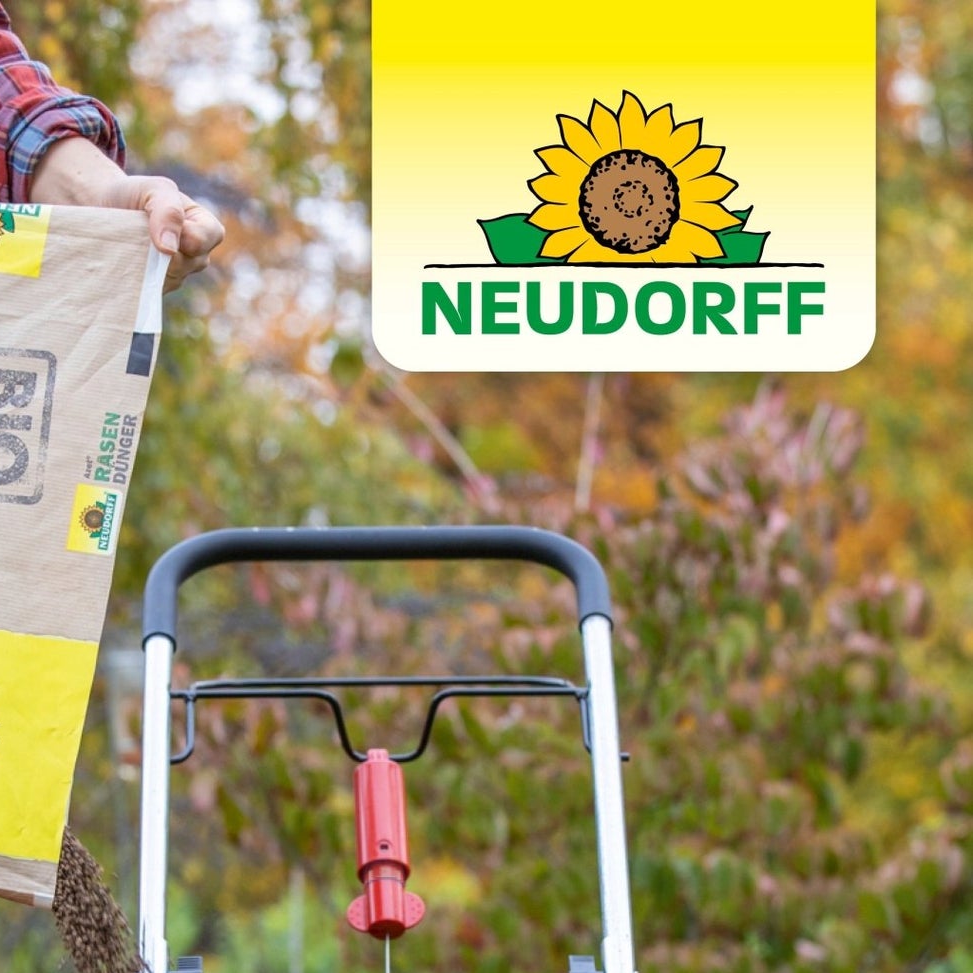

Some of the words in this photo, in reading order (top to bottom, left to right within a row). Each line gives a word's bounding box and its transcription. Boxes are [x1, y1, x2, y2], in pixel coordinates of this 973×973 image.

[94, 412, 121, 482] RASEN
[112, 414, 138, 485] DÜNGER
[99, 494, 118, 550] NEUDORFF
